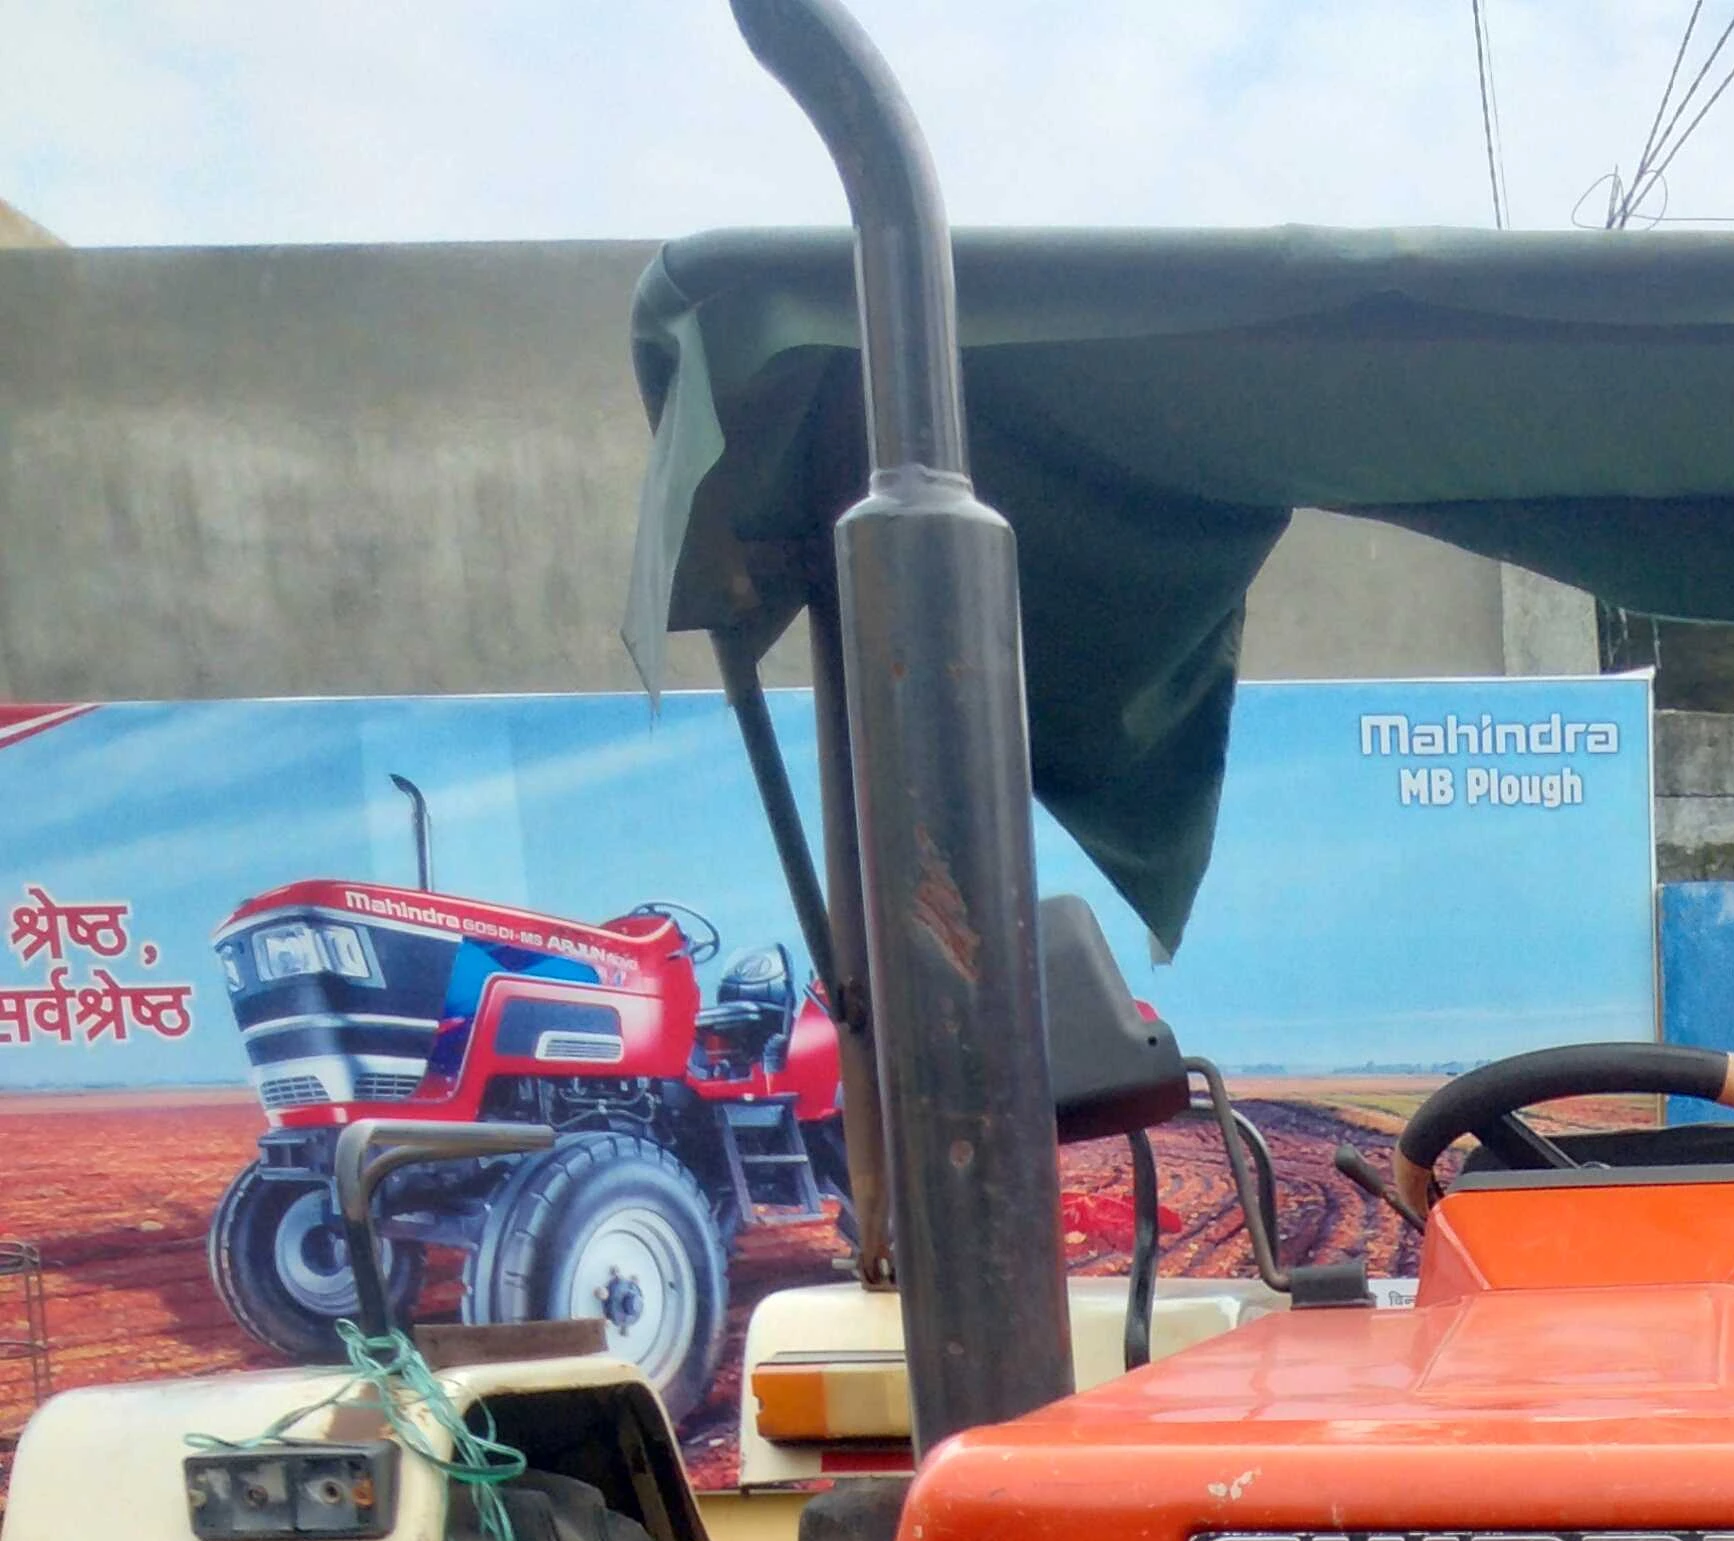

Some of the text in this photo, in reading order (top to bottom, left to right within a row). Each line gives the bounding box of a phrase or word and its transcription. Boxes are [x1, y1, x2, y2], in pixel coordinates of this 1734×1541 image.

[1360, 713, 1619, 756] Mahindra
[1400, 766, 1584, 809] MB Plough
[345, 890, 461, 929] Mahindra
